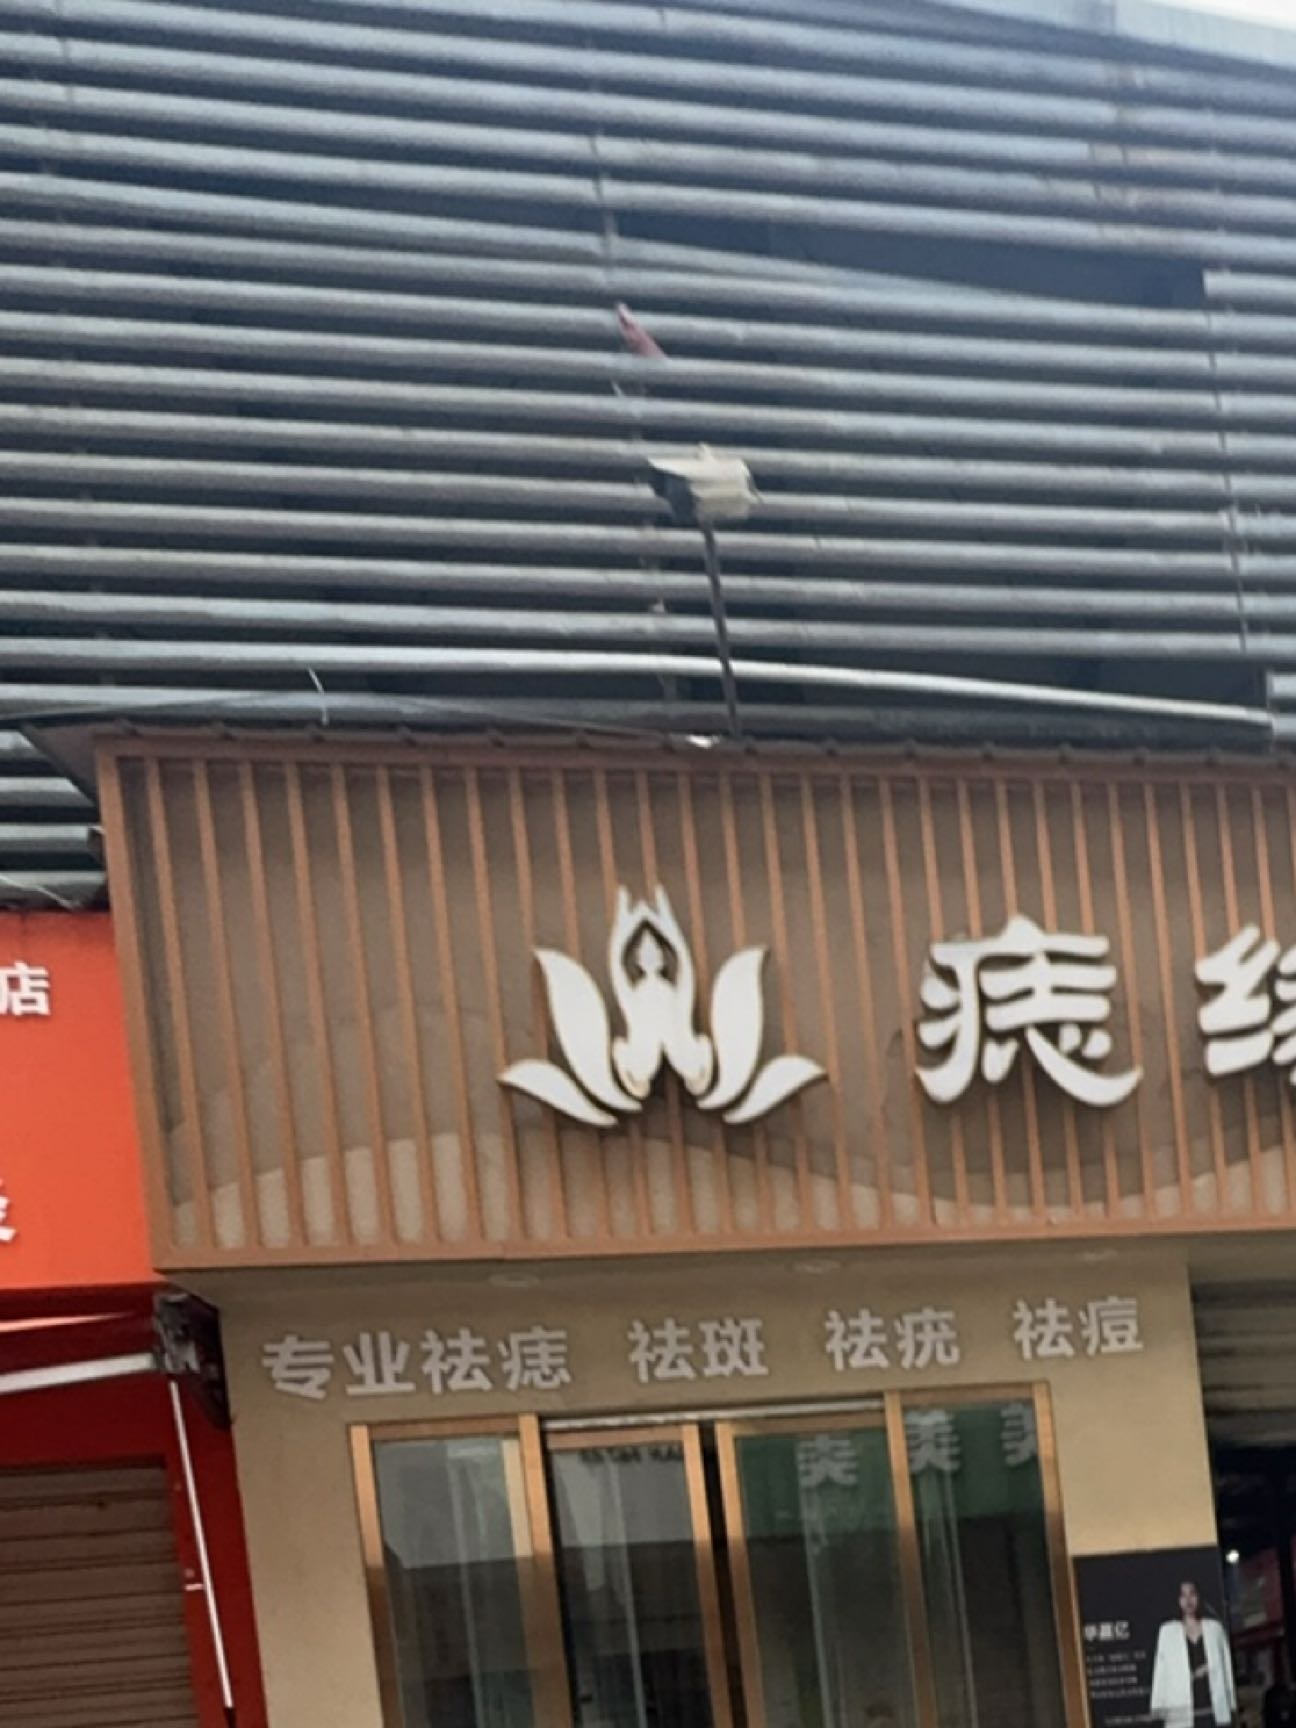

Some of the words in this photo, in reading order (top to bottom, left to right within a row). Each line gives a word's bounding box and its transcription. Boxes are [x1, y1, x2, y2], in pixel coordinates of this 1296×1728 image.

[261, 1325, 573, 1399] 专业祛痣
[626, 1317, 769, 1384] 祛斑
[824, 1305, 960, 1371] 祛疣
[1012, 1295, 1144, 1361] 祛痘
